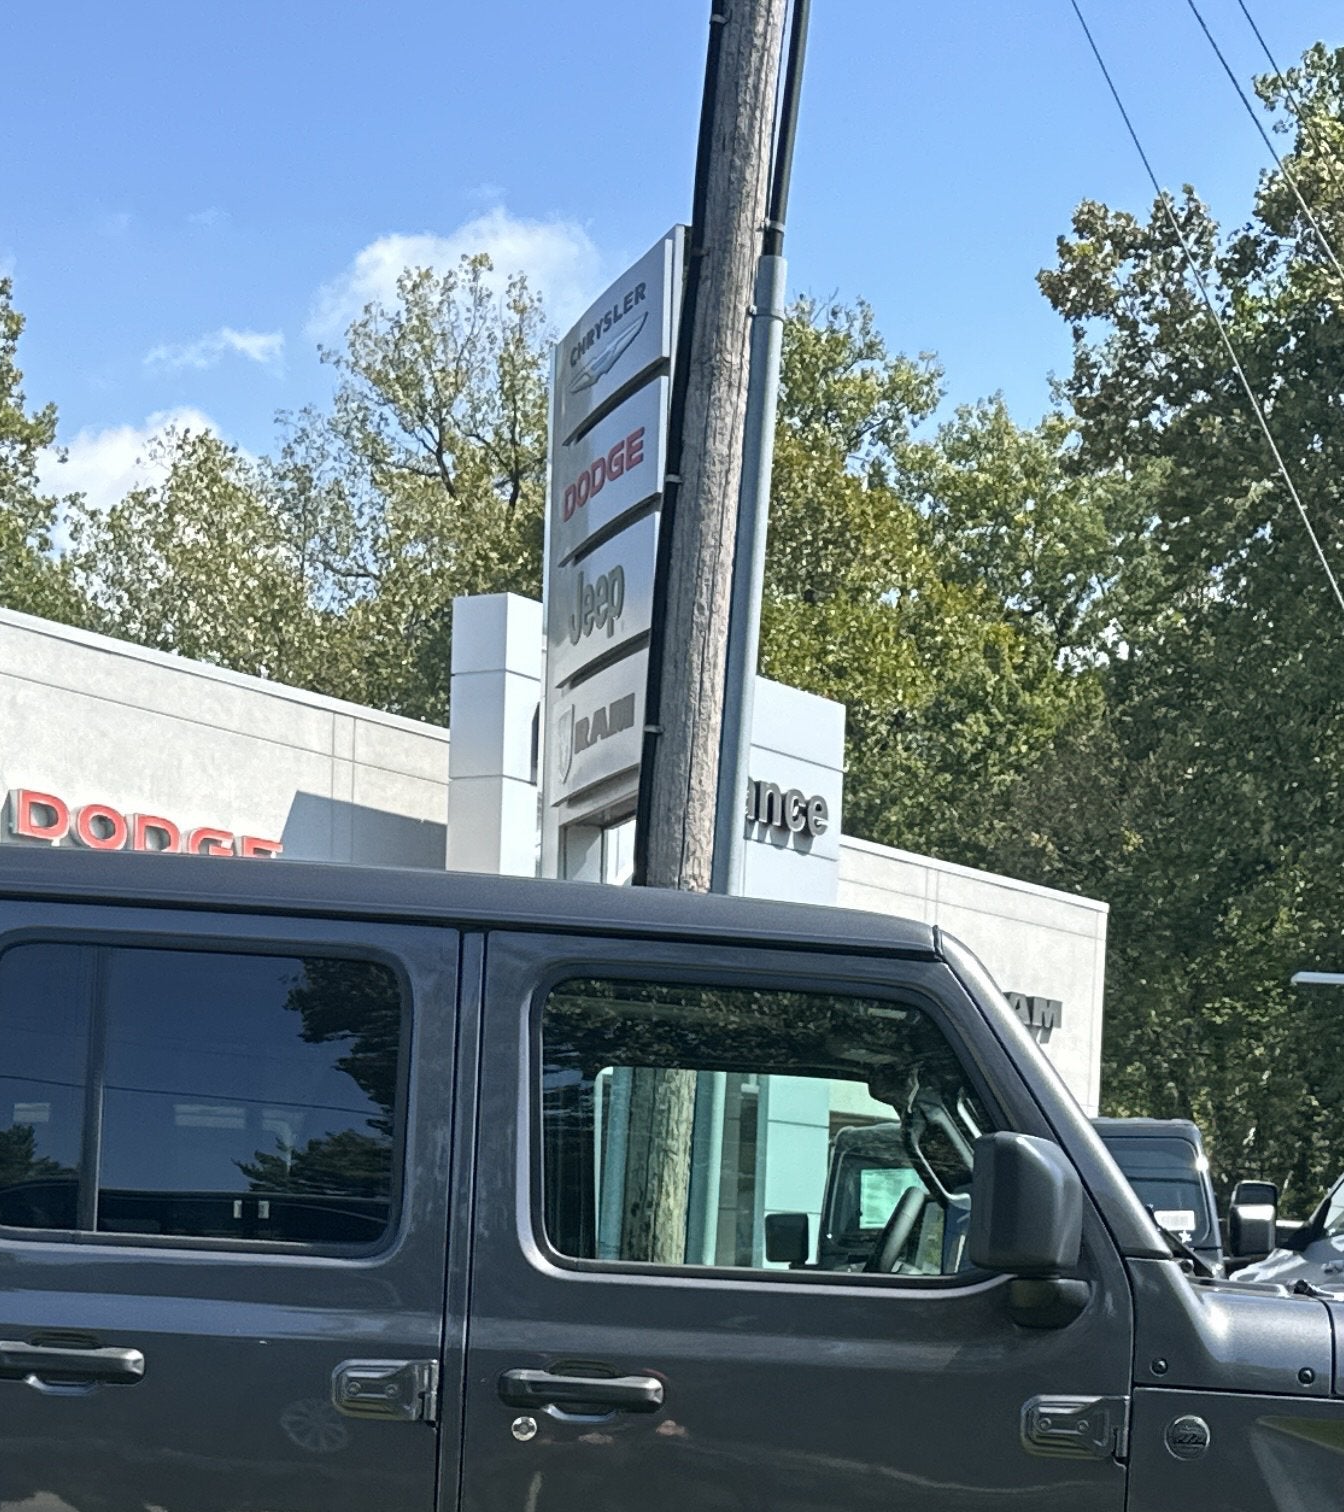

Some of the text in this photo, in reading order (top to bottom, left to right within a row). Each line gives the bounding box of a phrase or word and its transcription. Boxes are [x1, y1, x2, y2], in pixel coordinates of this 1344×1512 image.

[570, 282, 646, 367] CHRYSLER
[563, 426, 645, 522] DODGE
[569, 565, 624, 646] Jeep
[574, 692, 635, 755] RAM
[1002, 991, 1063, 1029] AM
